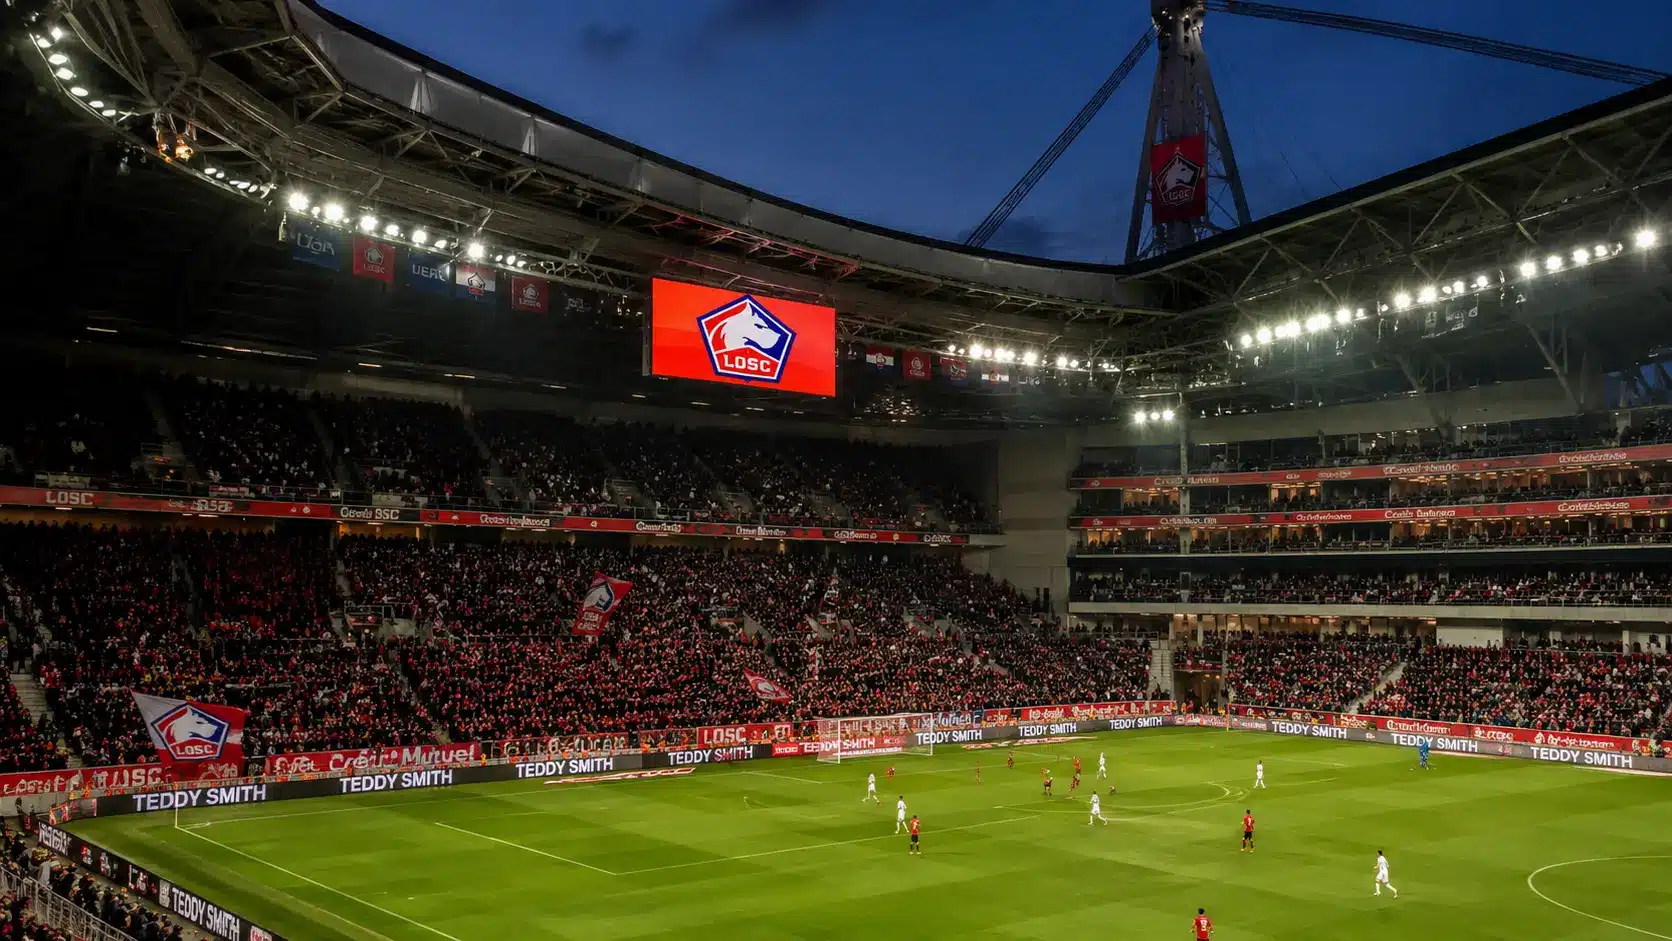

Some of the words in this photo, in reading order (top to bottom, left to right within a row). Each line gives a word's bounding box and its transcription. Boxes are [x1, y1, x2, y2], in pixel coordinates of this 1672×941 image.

[723, 354, 771, 373] LOSC
[45, 490, 94, 506] LOSC
[1018, 724, 1049, 737] TEDDY
[1050, 722, 1077, 735] SMITH
[1137, 716, 1163, 728] SMITH
[1271, 721, 1311, 735] TEDDY
[1311, 725, 1348, 739] SMITH
[703, 727, 746, 745] LOSC
[916, 731, 951, 746] TEDDY
[951, 729, 983, 742] SMITH
[1390, 733, 1435, 748] TEDDY
[1436, 738, 1478, 753] SMITH
[176, 742, 214, 756] LOSC
[668, 749, 713, 766] TEDDY
[713, 746, 754, 762] SMITH
[1530, 746, 1582, 763] TEDDY
[1584, 752, 1633, 769] SMITH
[515, 760, 568, 779] TEDDY
[568, 757, 614, 774] SMITH
[339, 773, 399, 793] TEDDY
[401, 769, 453, 788] SMITH
[132, 789, 202, 813] TEDDY
[206, 784, 267, 806] SMITH
[171, 886, 207, 922] TEDDY
[206, 902, 240, 941] SMITH
